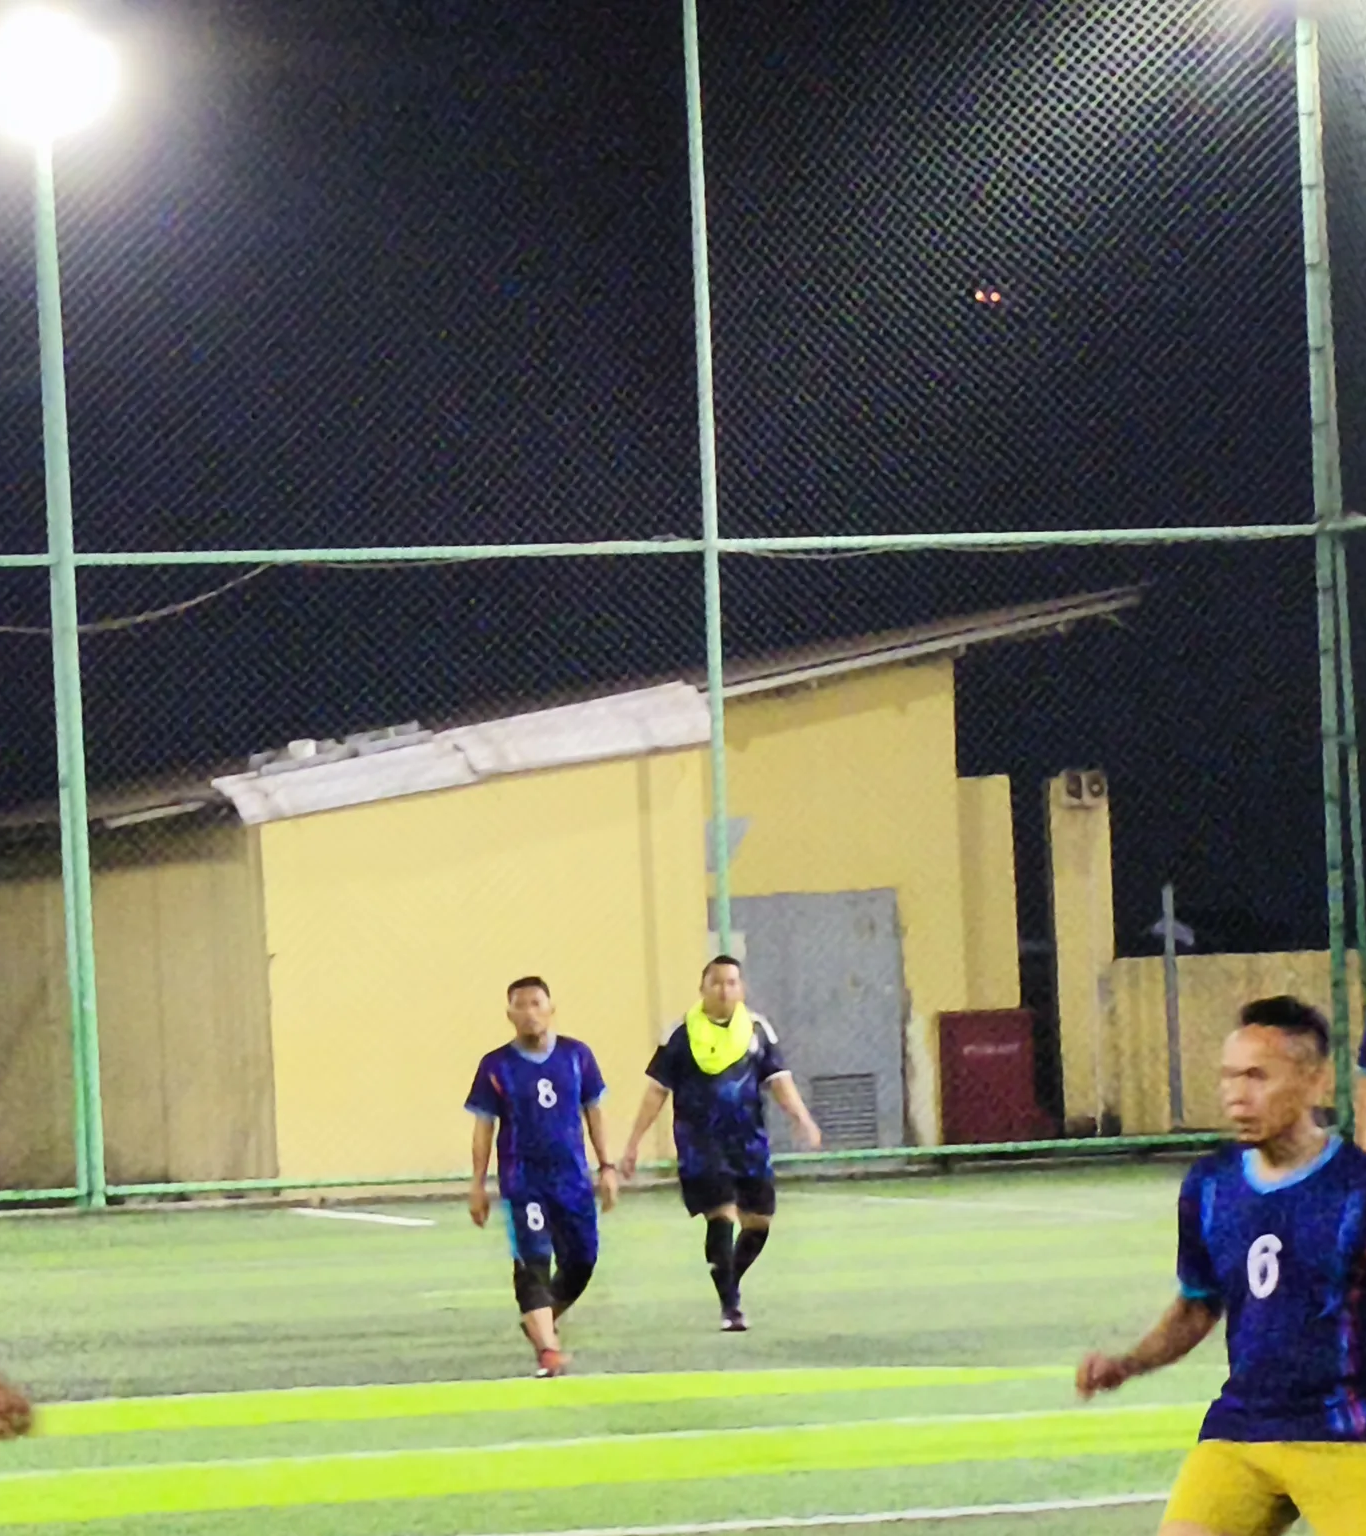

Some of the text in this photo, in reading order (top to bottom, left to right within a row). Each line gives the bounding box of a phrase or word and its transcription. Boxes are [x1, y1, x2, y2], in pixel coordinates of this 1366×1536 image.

[537, 1078, 558, 1109] 8
[526, 1202, 545, 1231] 8
[1247, 1233, 1283, 1299] 6
